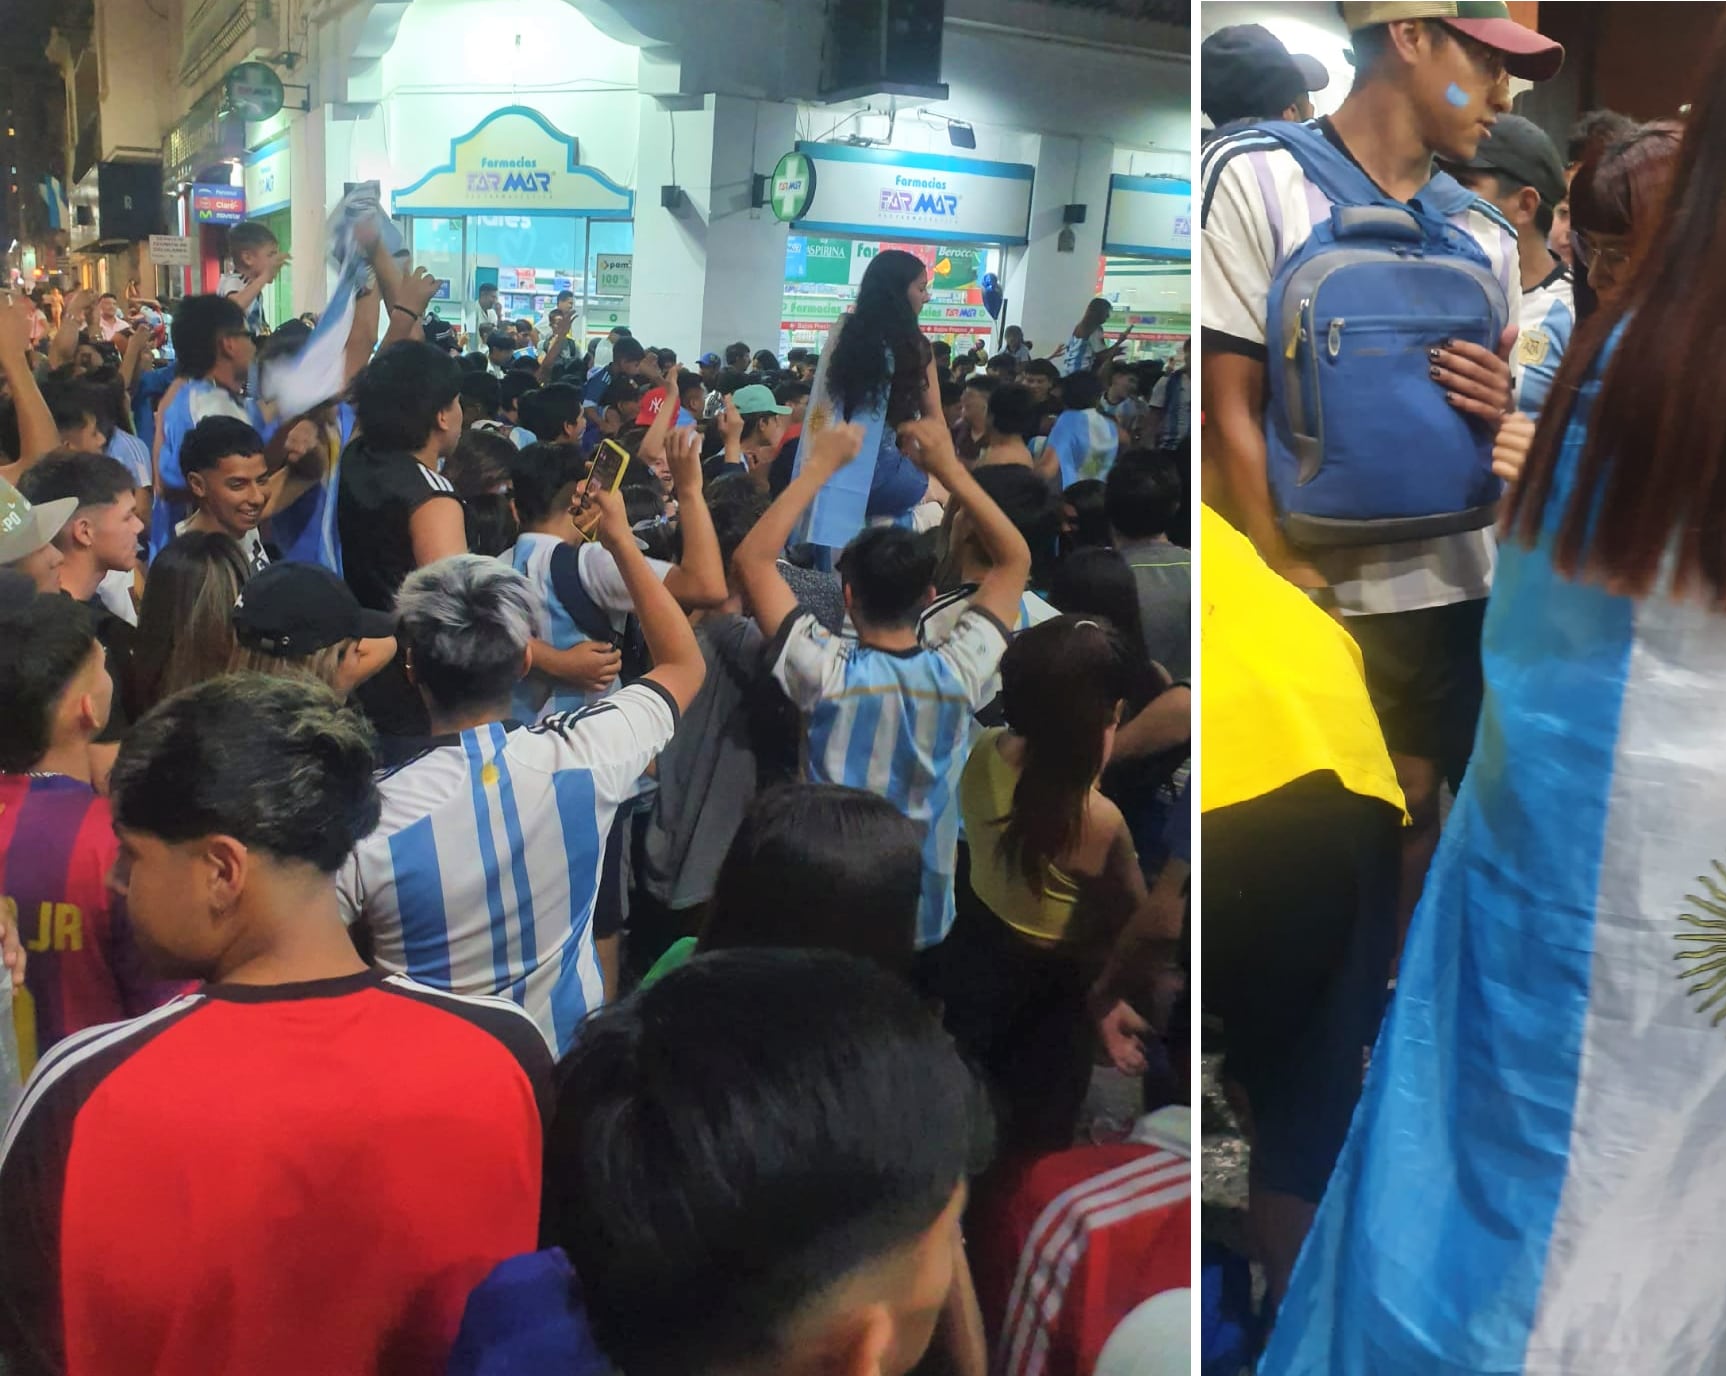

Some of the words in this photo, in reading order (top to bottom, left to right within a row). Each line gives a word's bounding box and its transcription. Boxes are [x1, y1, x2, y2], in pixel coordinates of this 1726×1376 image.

[481, 156, 537, 168] Farmacias
[895, 175, 947, 190] Farmacias
[27, 901, 83, 952] JR
